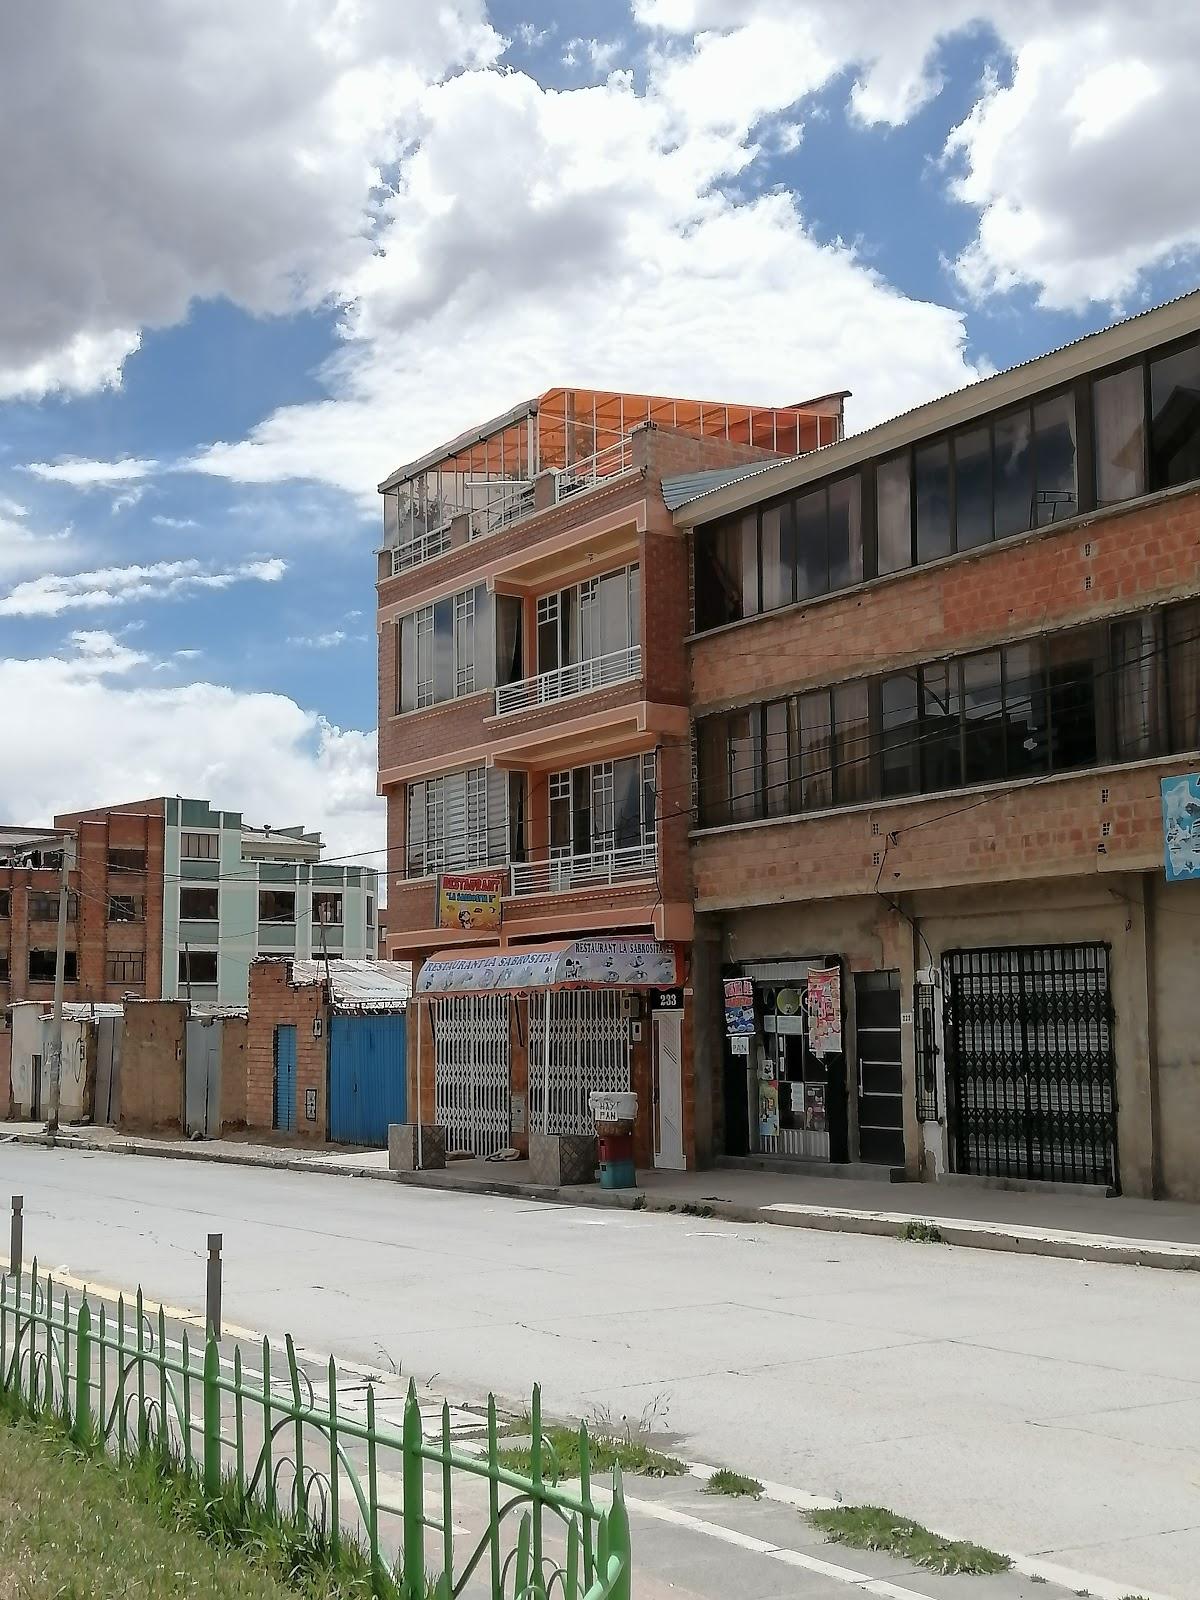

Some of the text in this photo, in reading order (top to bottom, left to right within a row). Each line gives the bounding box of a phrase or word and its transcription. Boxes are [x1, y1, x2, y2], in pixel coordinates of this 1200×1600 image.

[442, 876, 500, 892] RESTAURANT
[575, 942, 617, 954] RESTAURANT
[619, 943, 628, 954] LA
[629, 943, 664, 954] SABROSITA
[424, 959, 482, 972] RESTAURANT
[483, 957, 498, 968] LA
[498, 953, 553, 967] SABROSITA
[660, 994, 677, 1006] 233
[733, 1044, 747, 1052] PAN
[600, 1102, 615, 1111] HAY
[600, 1111, 616, 1120] PAN
